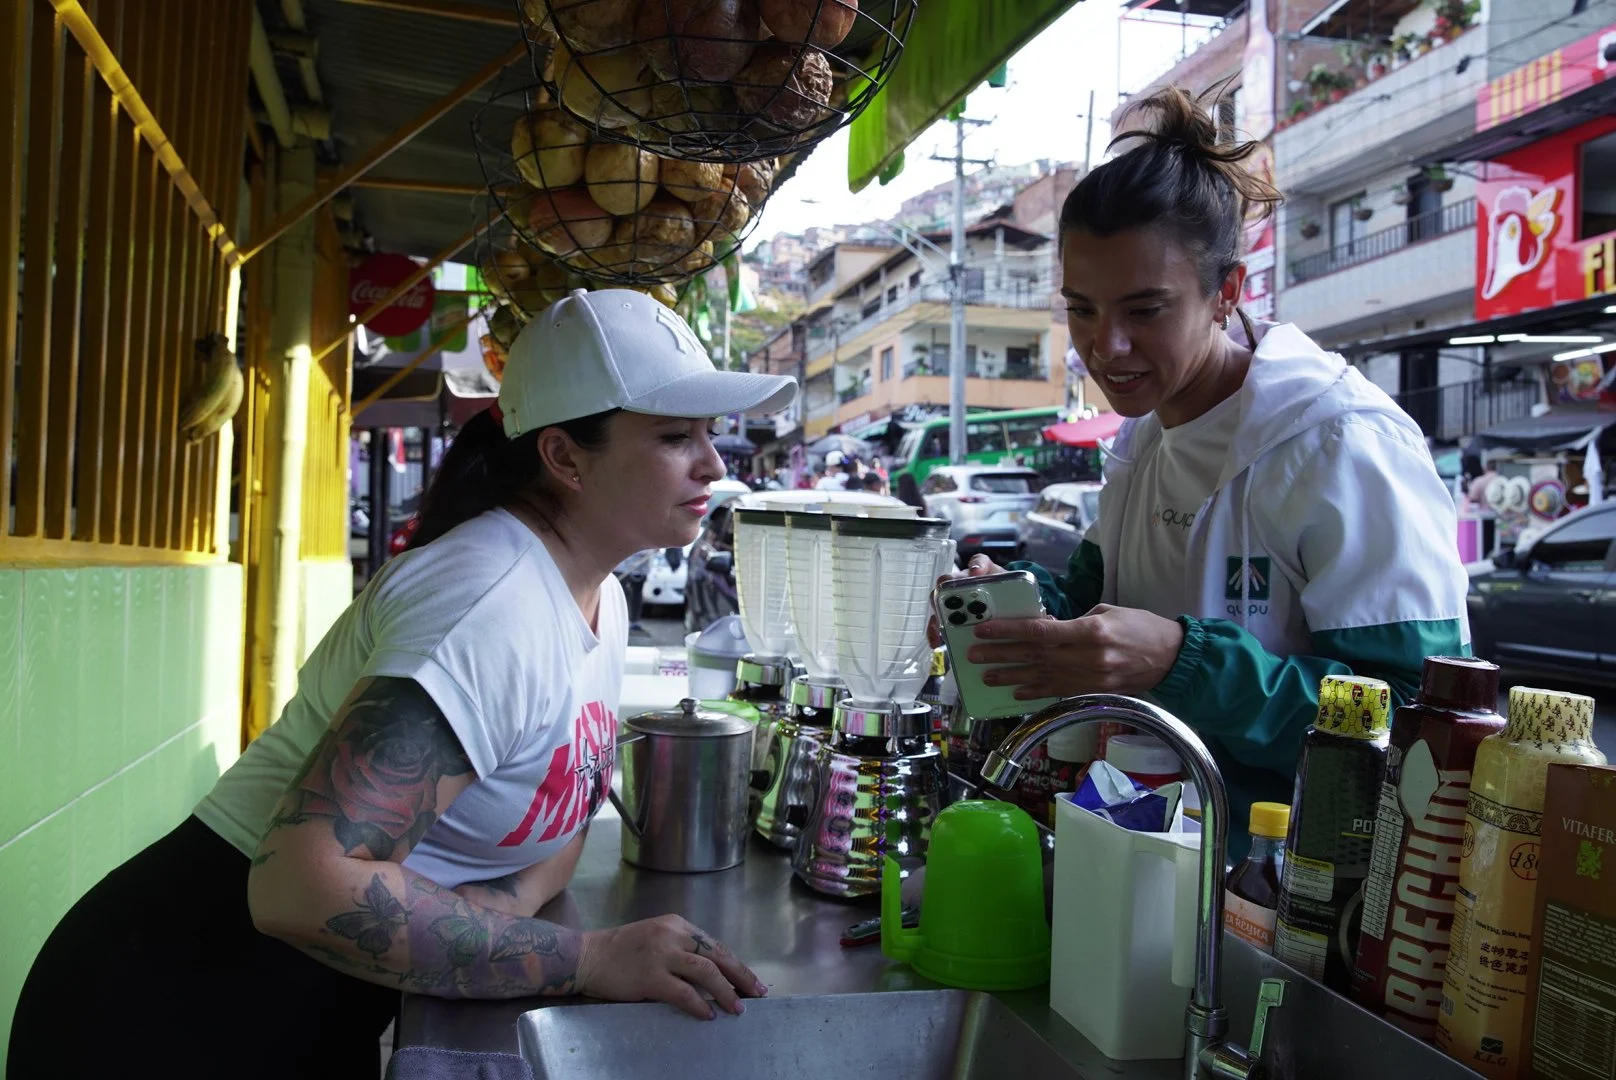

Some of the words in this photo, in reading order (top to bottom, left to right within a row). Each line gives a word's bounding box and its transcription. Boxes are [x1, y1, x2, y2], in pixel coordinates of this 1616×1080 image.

[1226, 604, 1269, 617] qupu
[1352, 818, 1375, 834] PO
[1512, 851, 1539, 871] 18
